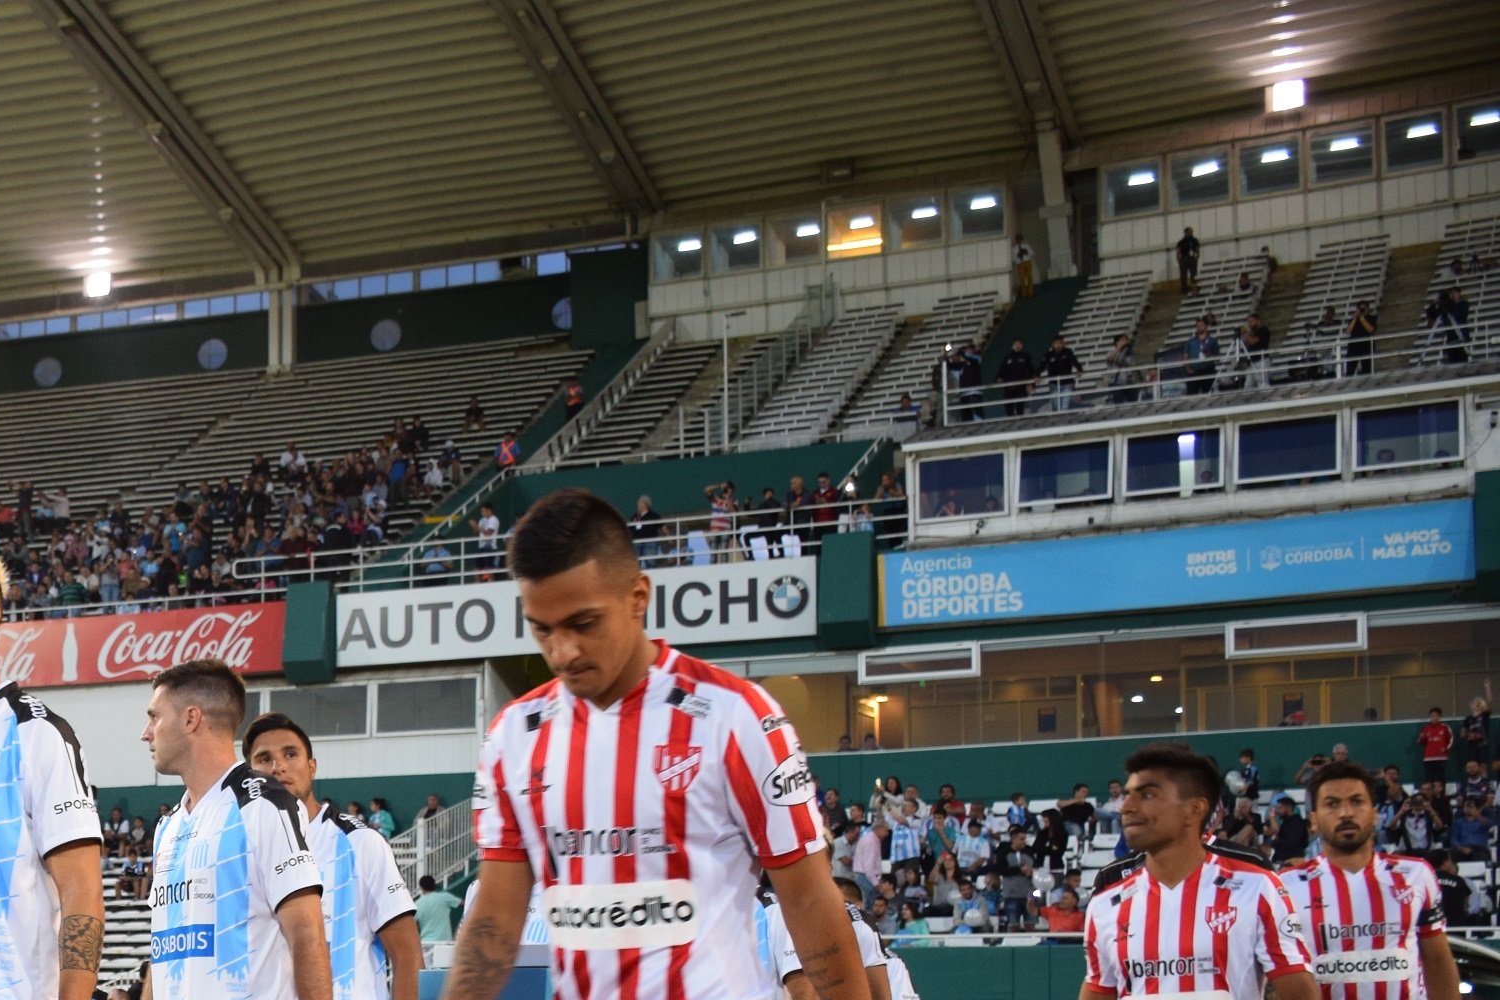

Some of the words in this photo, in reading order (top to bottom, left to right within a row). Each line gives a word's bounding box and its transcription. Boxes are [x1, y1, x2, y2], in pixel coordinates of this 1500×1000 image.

[1383, 529, 1441, 546] VAMOS
[1187, 550, 1236, 565] ENTRE
[1411, 541, 1452, 557] ALTO
[901, 553, 972, 577] Agencia
[1186, 562, 1237, 578] TODOS
[902, 571, 1012, 599] CÓRDOBA
[903, 591, 1024, 619] DEPORTES
[338, 598, 496, 652] AUTO
[97, 610, 262, 680] Coca-Cola
[1331, 922, 1387, 940] bancor
[1131, 957, 1196, 980] bancor
[1315, 956, 1409, 975] autocrédito
